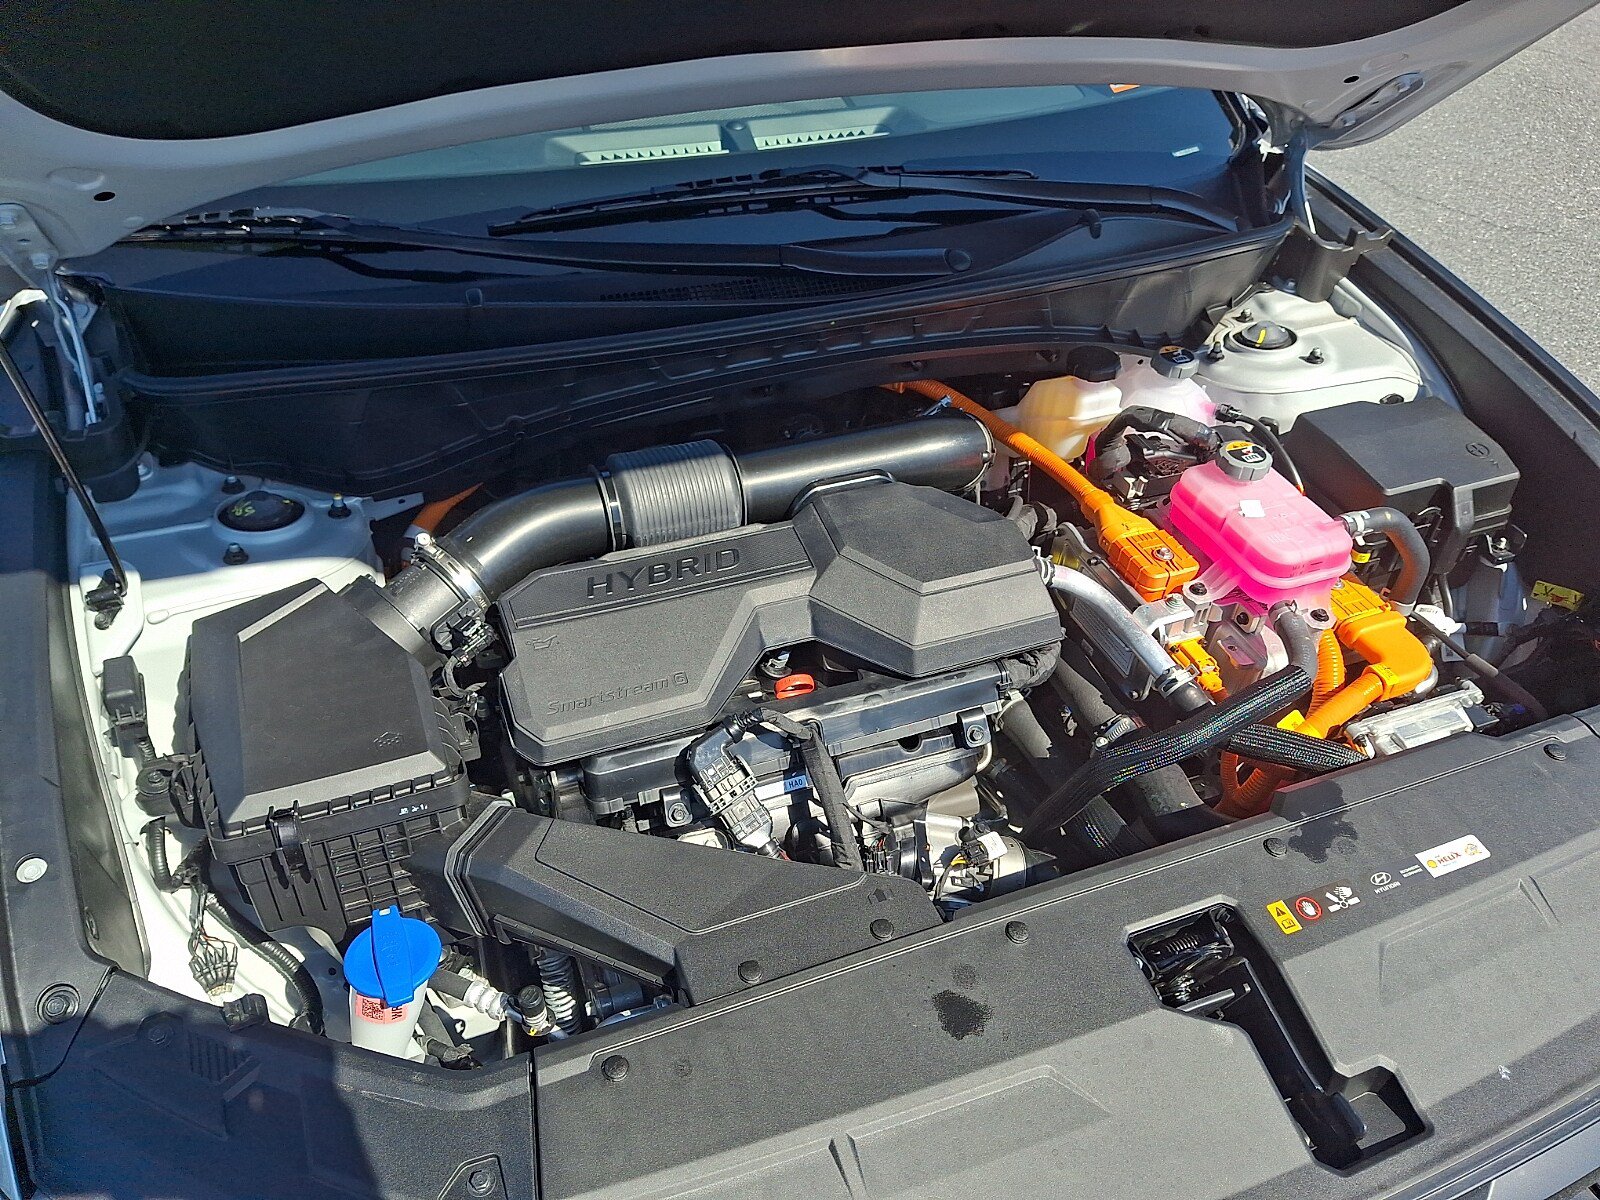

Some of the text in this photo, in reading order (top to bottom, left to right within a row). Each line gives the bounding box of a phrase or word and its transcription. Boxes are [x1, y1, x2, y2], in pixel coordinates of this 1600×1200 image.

[587, 548, 740, 599] HYBRID
[546, 677, 670, 715] Smartstream
[1437, 851, 1461, 864] HELIX
[1374, 881, 1401, 894] HYUNDAI
